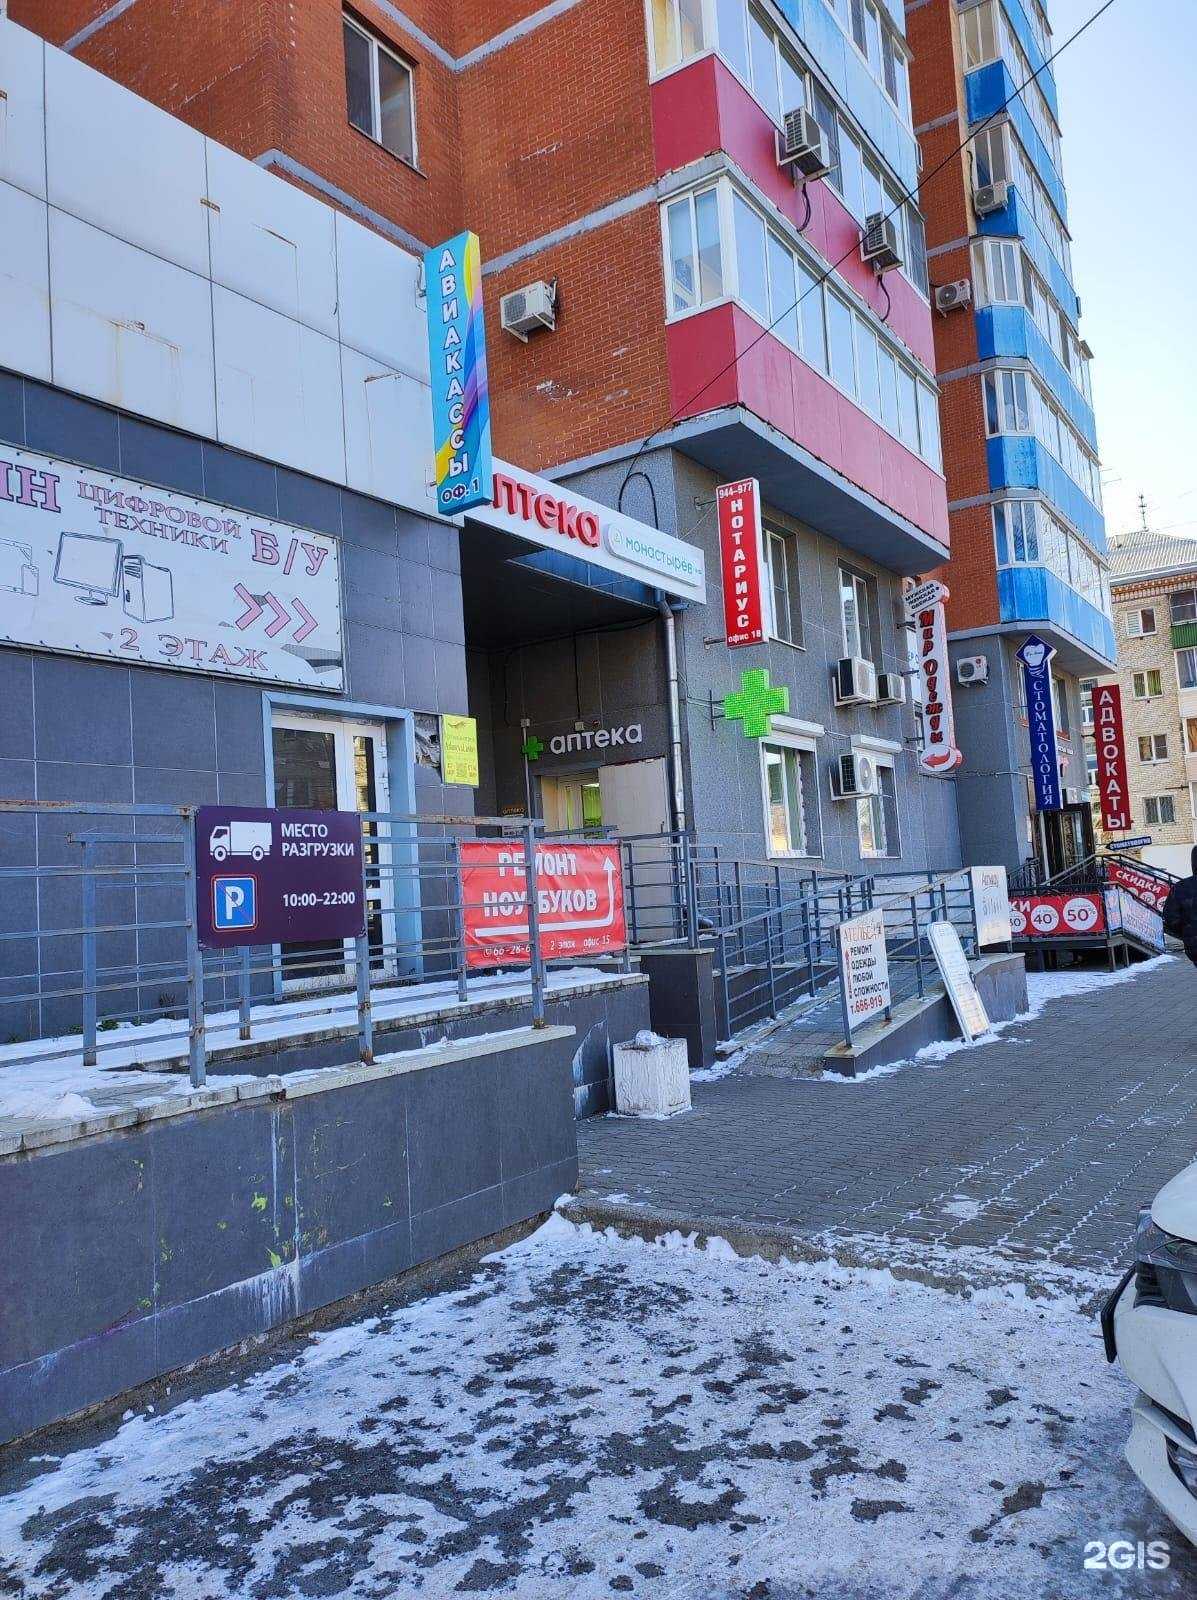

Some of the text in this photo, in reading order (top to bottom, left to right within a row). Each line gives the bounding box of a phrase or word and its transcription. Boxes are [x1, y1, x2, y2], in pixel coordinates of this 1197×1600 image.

[438, 249, 469, 477] АВИАКАССЫ
[718, 481, 753, 499] 944-977
[77, 480, 242, 540] ЦИФРОВОЙ
[251, 528, 328, 576] Б/У
[94, 506, 230, 555] ТЕХНИКИ
[731, 499, 750, 629] НОТАРИУС
[120, 628, 269, 671] 2 ЭТАЖ
[728, 632, 749, 645] офис
[550, 724, 643, 754] аптека
[1033, 680, 1053, 805] СТОМАТОЛОГИЯ
[1100, 690, 1126, 828] АДВОКАТЫ
[281, 823, 328, 838] МЕСТО
[282, 842, 355, 857] РАЗГРУЗКИ
[1116, 870, 1162, 894] СКИДКИ
[484, 889, 598, 917] НОУБУКОВ
[851, 958, 877, 970] ОДЕЖДЫ
[854, 981, 888, 997] СЛОЖНОСТИ
